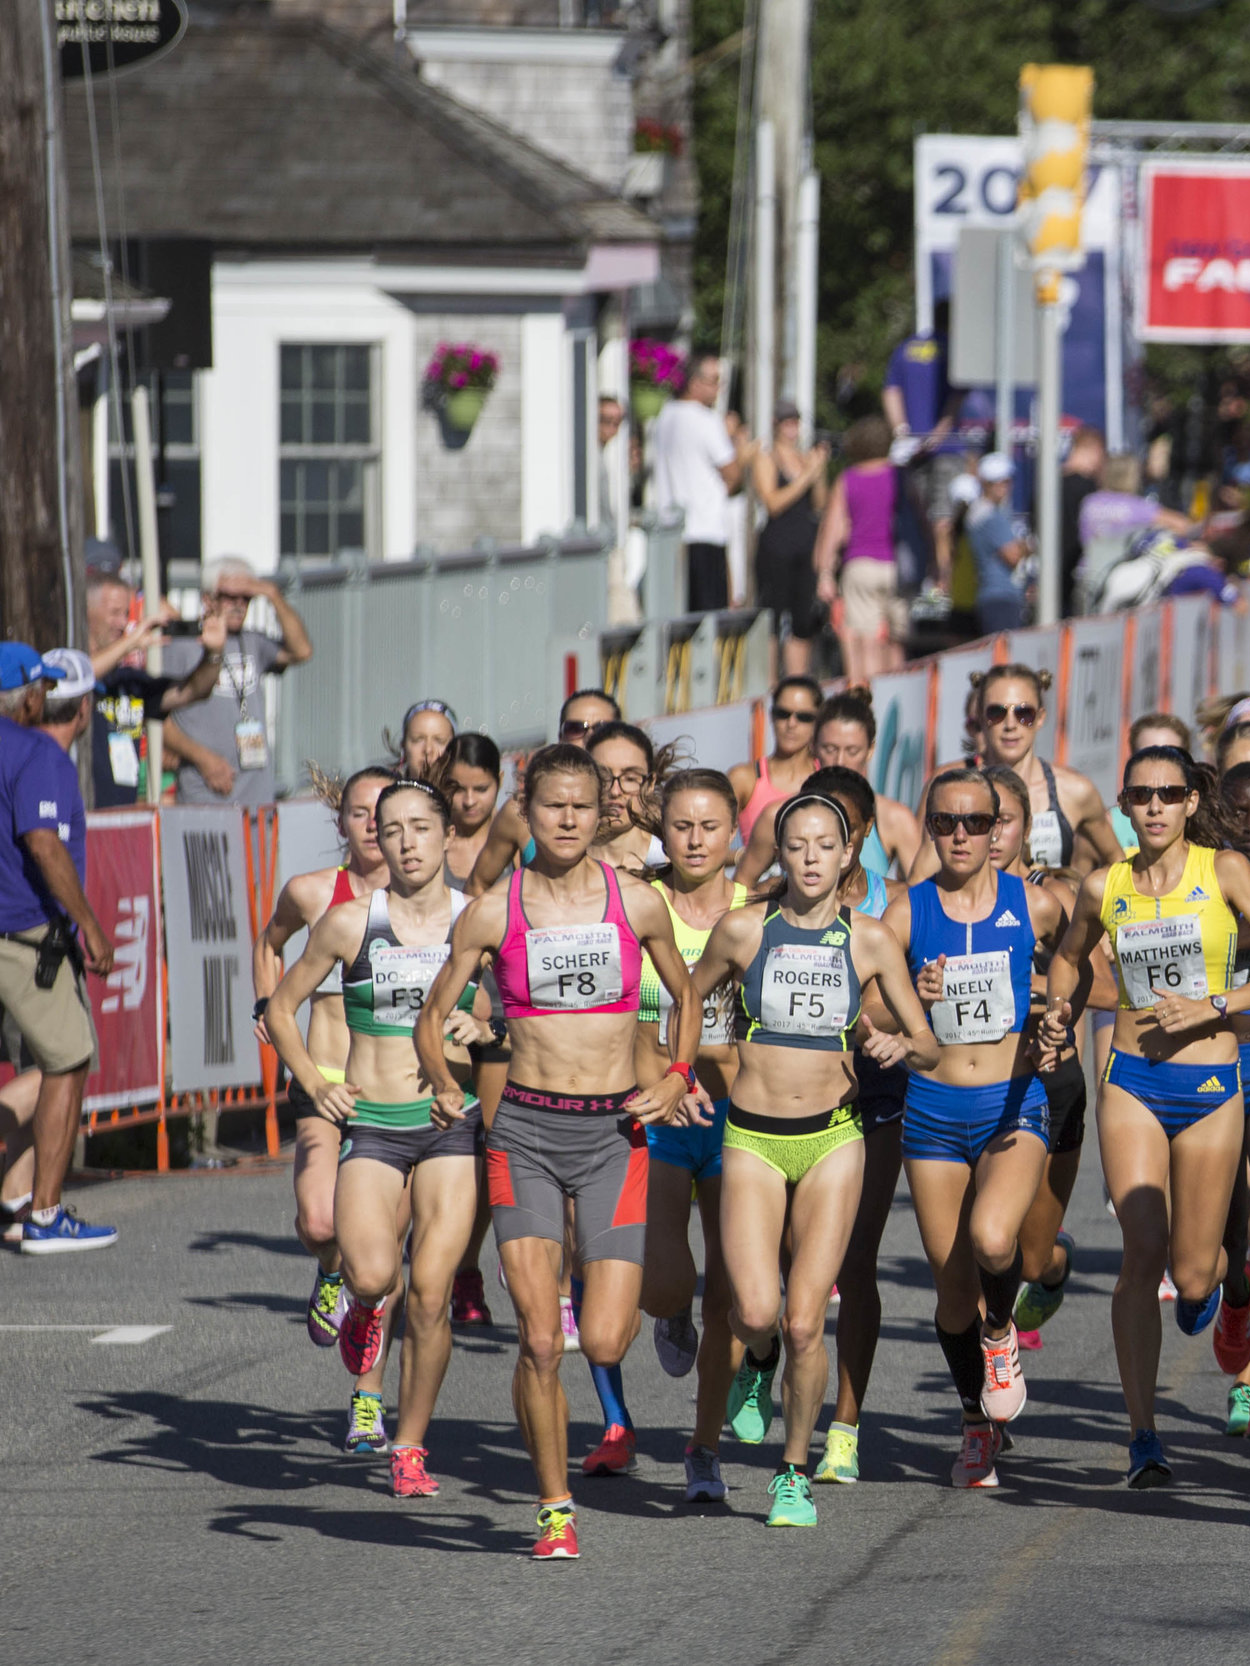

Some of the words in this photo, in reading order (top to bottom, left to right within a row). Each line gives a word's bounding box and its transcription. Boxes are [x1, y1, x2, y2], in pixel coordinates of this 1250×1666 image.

[542, 951, 611, 971] SCHERF
[1120, 941, 1203, 965] MATTHEWS
[558, 971, 597, 998] F8
[773, 970, 842, 987] ROGERS
[1146, 962, 1182, 988] F6
[391, 987, 424, 1010] F3
[946, 978, 994, 997] NEELY
[788, 991, 825, 1018] F5
[955, 999, 991, 1026] F4
